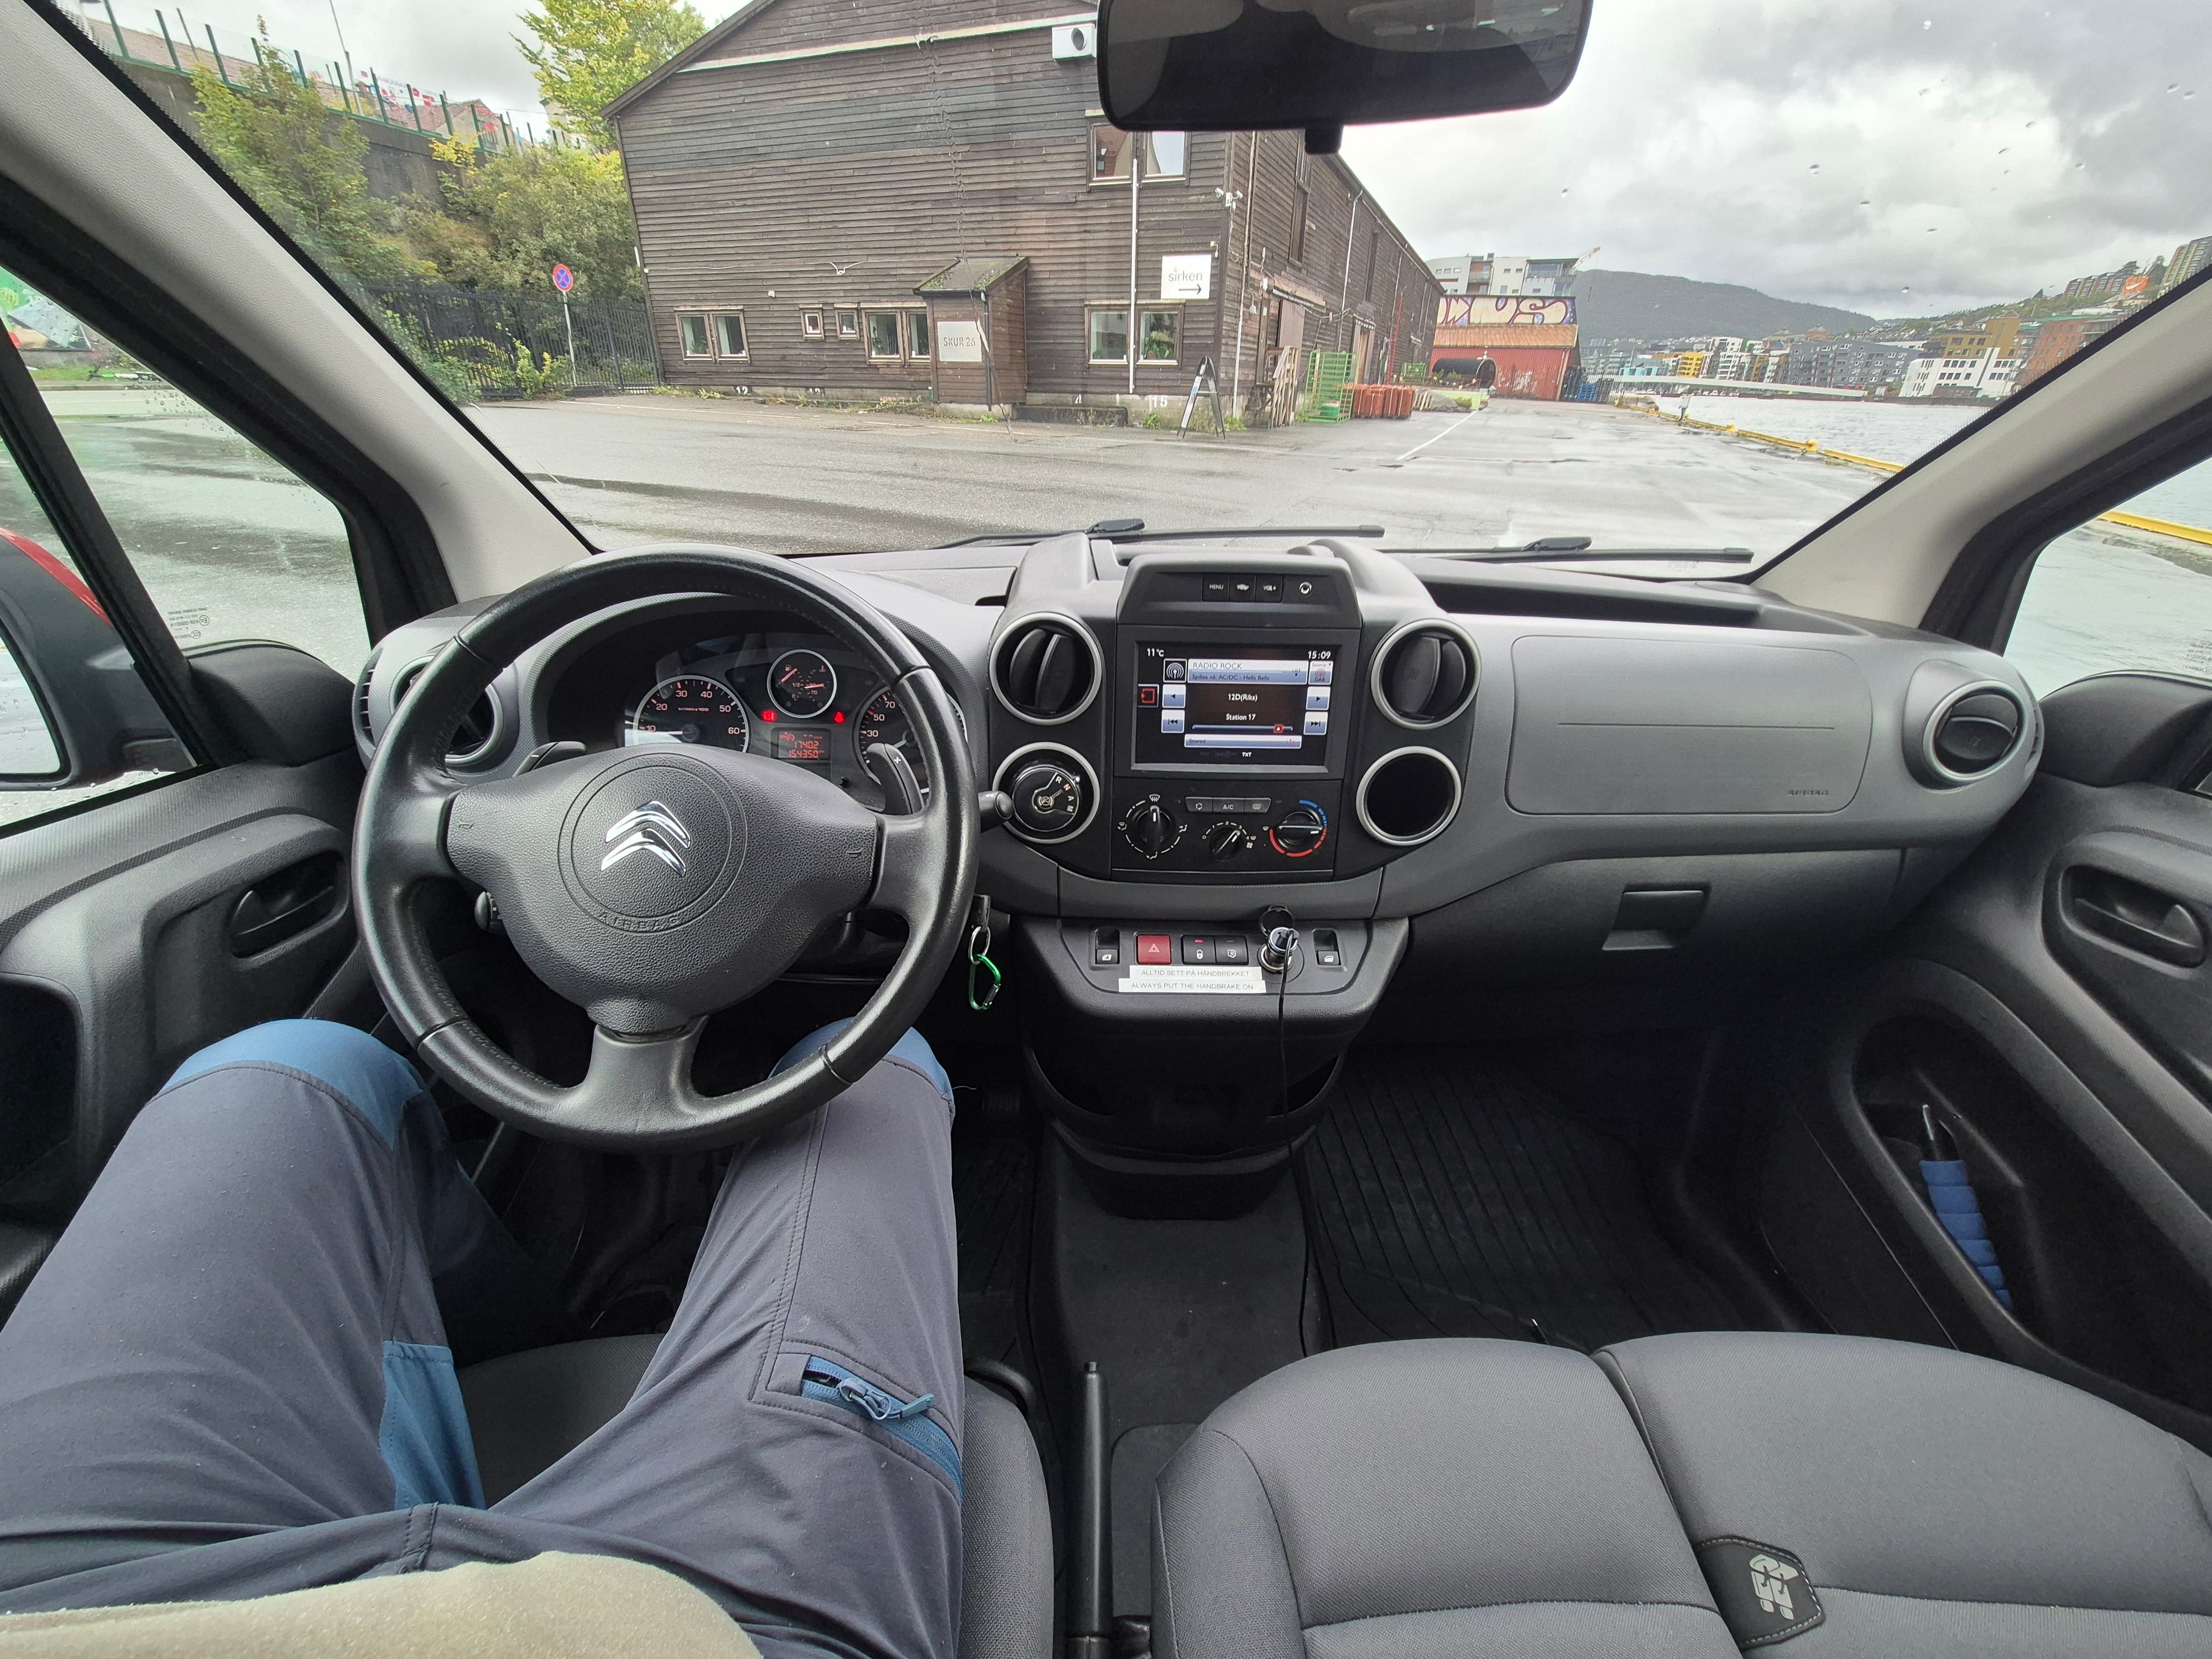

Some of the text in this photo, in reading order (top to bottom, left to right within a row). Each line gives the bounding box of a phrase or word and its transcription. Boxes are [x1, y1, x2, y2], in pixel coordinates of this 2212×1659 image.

[943, 337, 975, 346] SKUR 26
[1307, 650, 1331, 659] 15:09
[1228, 693, 1258, 702] 12D(Riks)
